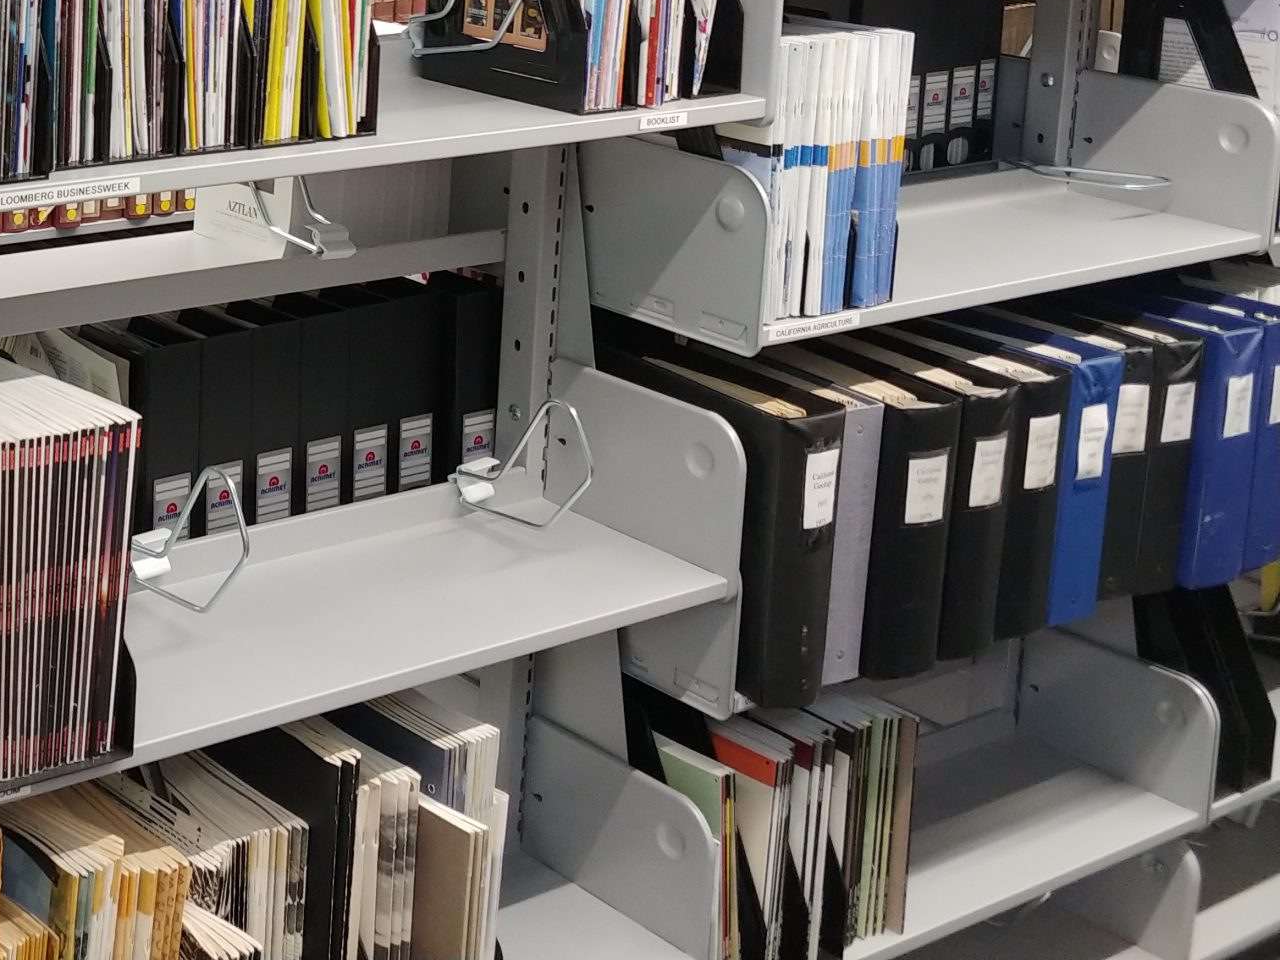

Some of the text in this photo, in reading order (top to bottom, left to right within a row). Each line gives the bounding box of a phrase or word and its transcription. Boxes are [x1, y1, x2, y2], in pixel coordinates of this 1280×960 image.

[647, 116, 680, 126] BOOKLIST
[57, 182, 130, 198] BUSINESSWEEK
[226, 200, 258, 220] AZTLAN
[776, 318, 853, 337] CALIFORNIA AGRICULTURE
